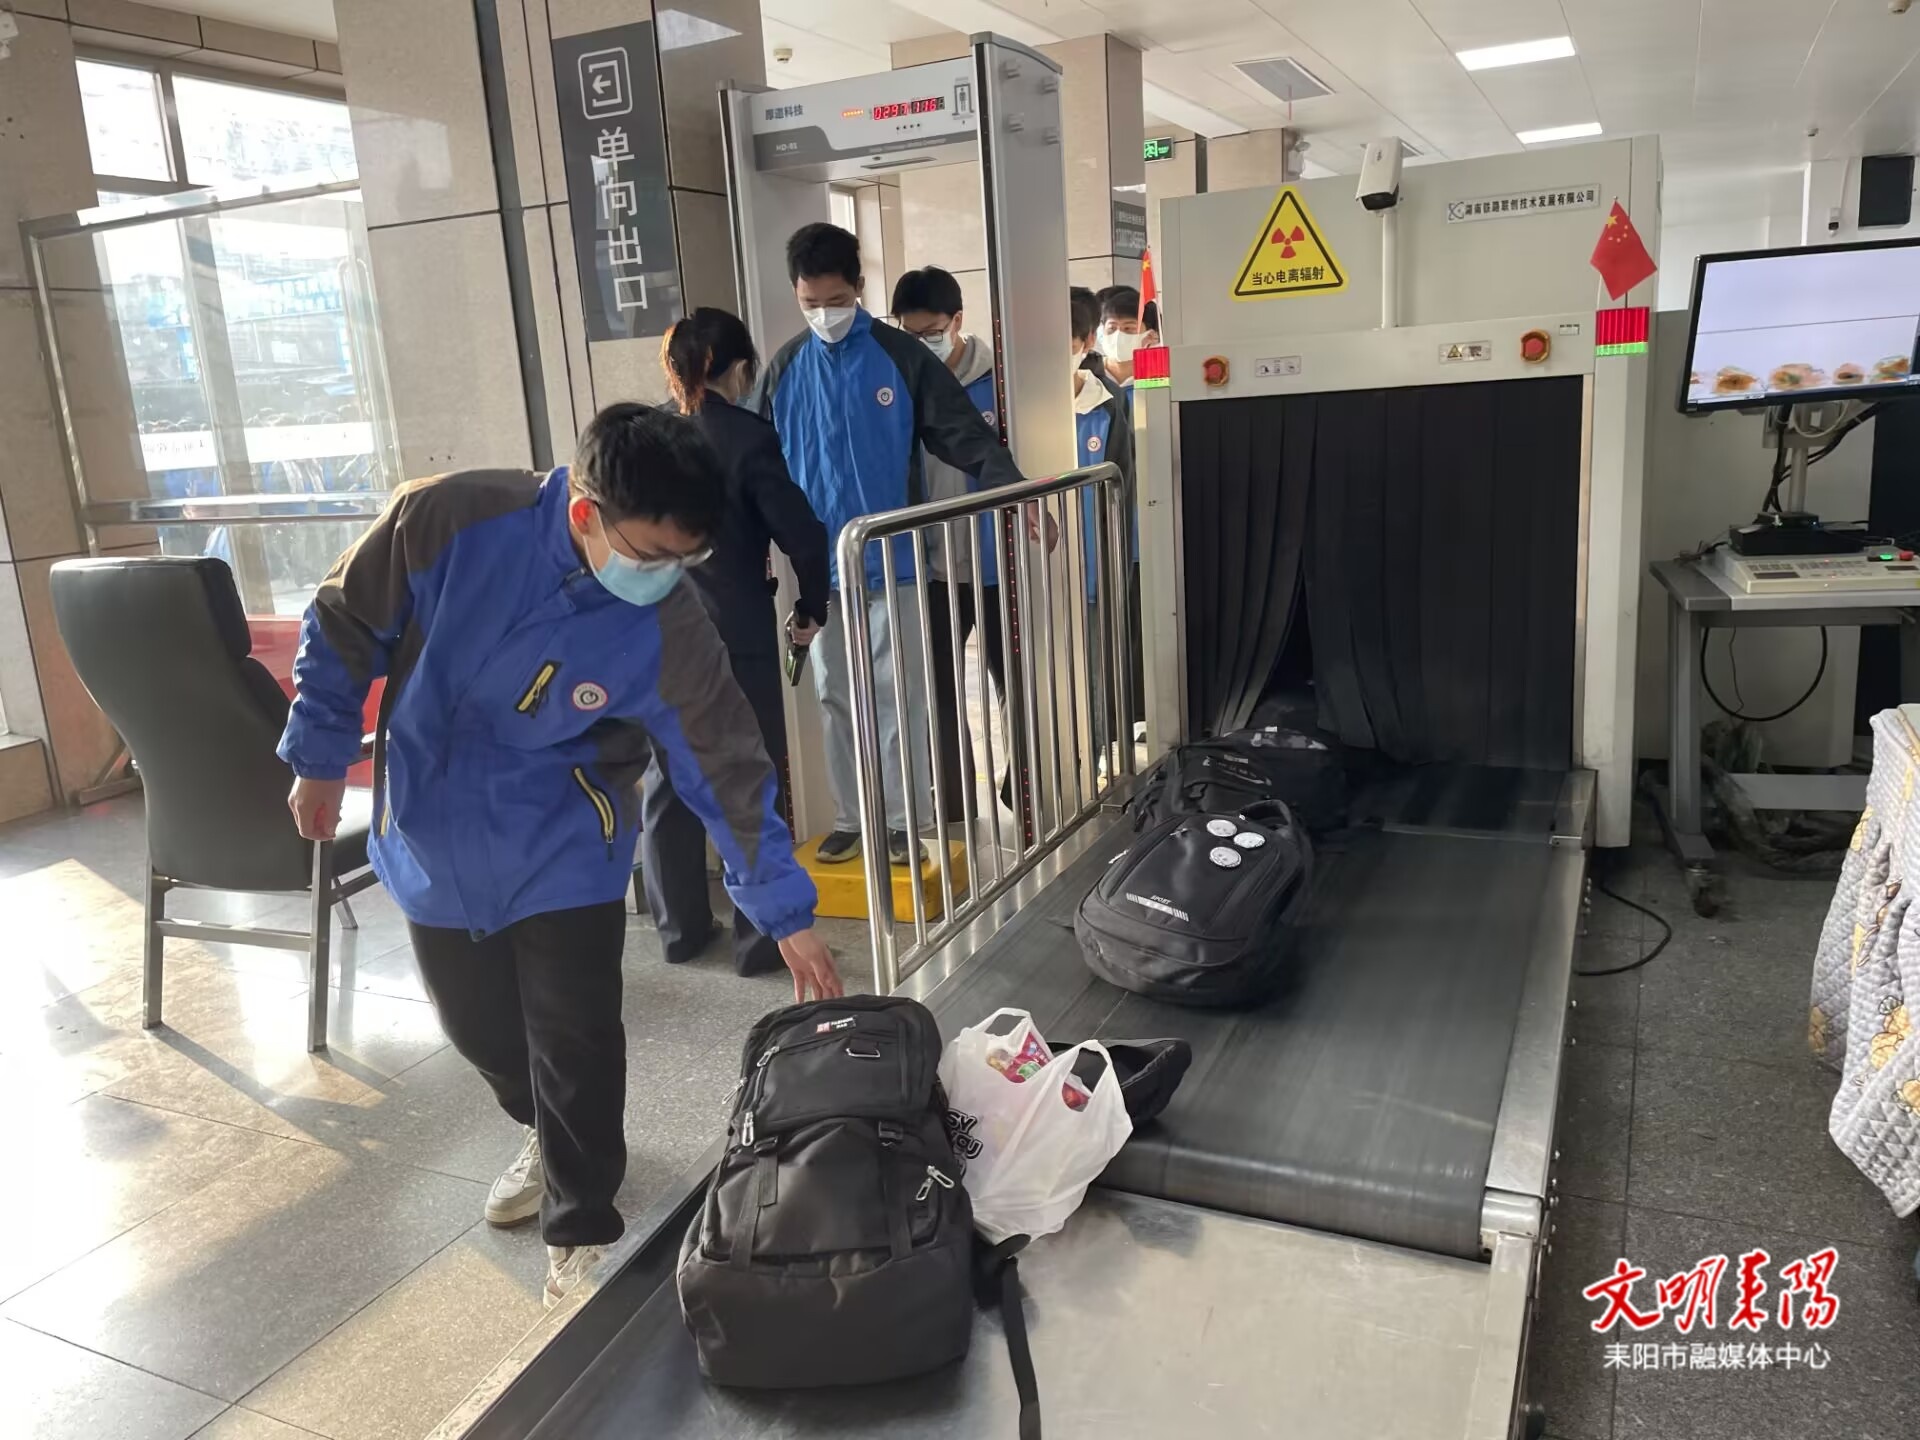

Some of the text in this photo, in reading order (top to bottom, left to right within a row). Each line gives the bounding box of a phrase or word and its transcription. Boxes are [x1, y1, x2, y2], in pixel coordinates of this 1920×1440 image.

[596, 125, 649, 312] 单向出口
[1252, 265, 1325, 286] 当心电离辐射
[1150, 894, 1173, 905] SPORT
